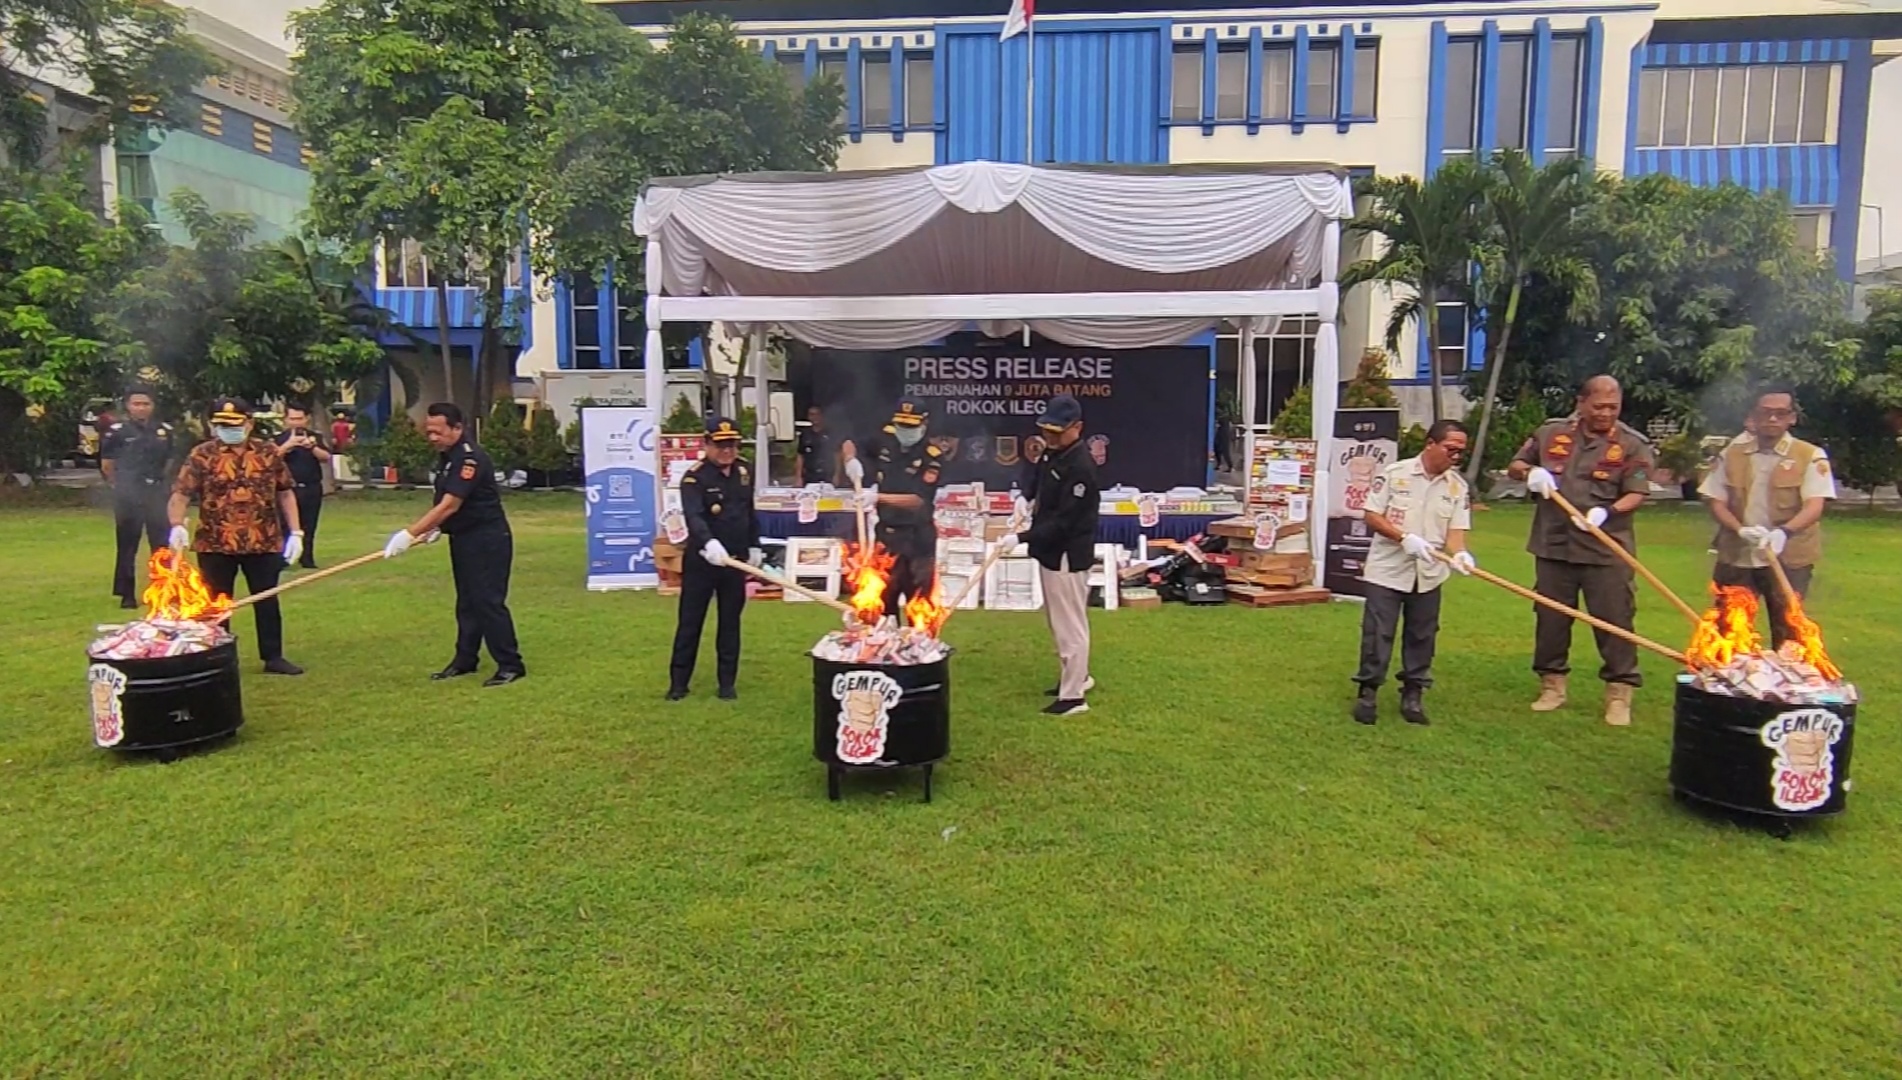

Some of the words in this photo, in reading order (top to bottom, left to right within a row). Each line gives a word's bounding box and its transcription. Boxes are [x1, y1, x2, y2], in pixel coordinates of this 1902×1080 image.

[904, 357, 988, 380] PRESS
[995, 357, 1113, 379] RELEASE
[904, 384, 1000, 397] PEMUSNAHAN
[1015, 384, 1050, 397] JUTA
[1053, 384, 1112, 397] BATANG
[946, 400, 1007, 415] ROKOK
[1339, 443, 1389, 467] GEMPUR
[836, 675, 898, 703] GEMPUR
[1768, 714, 1841, 743] GEMPUR
